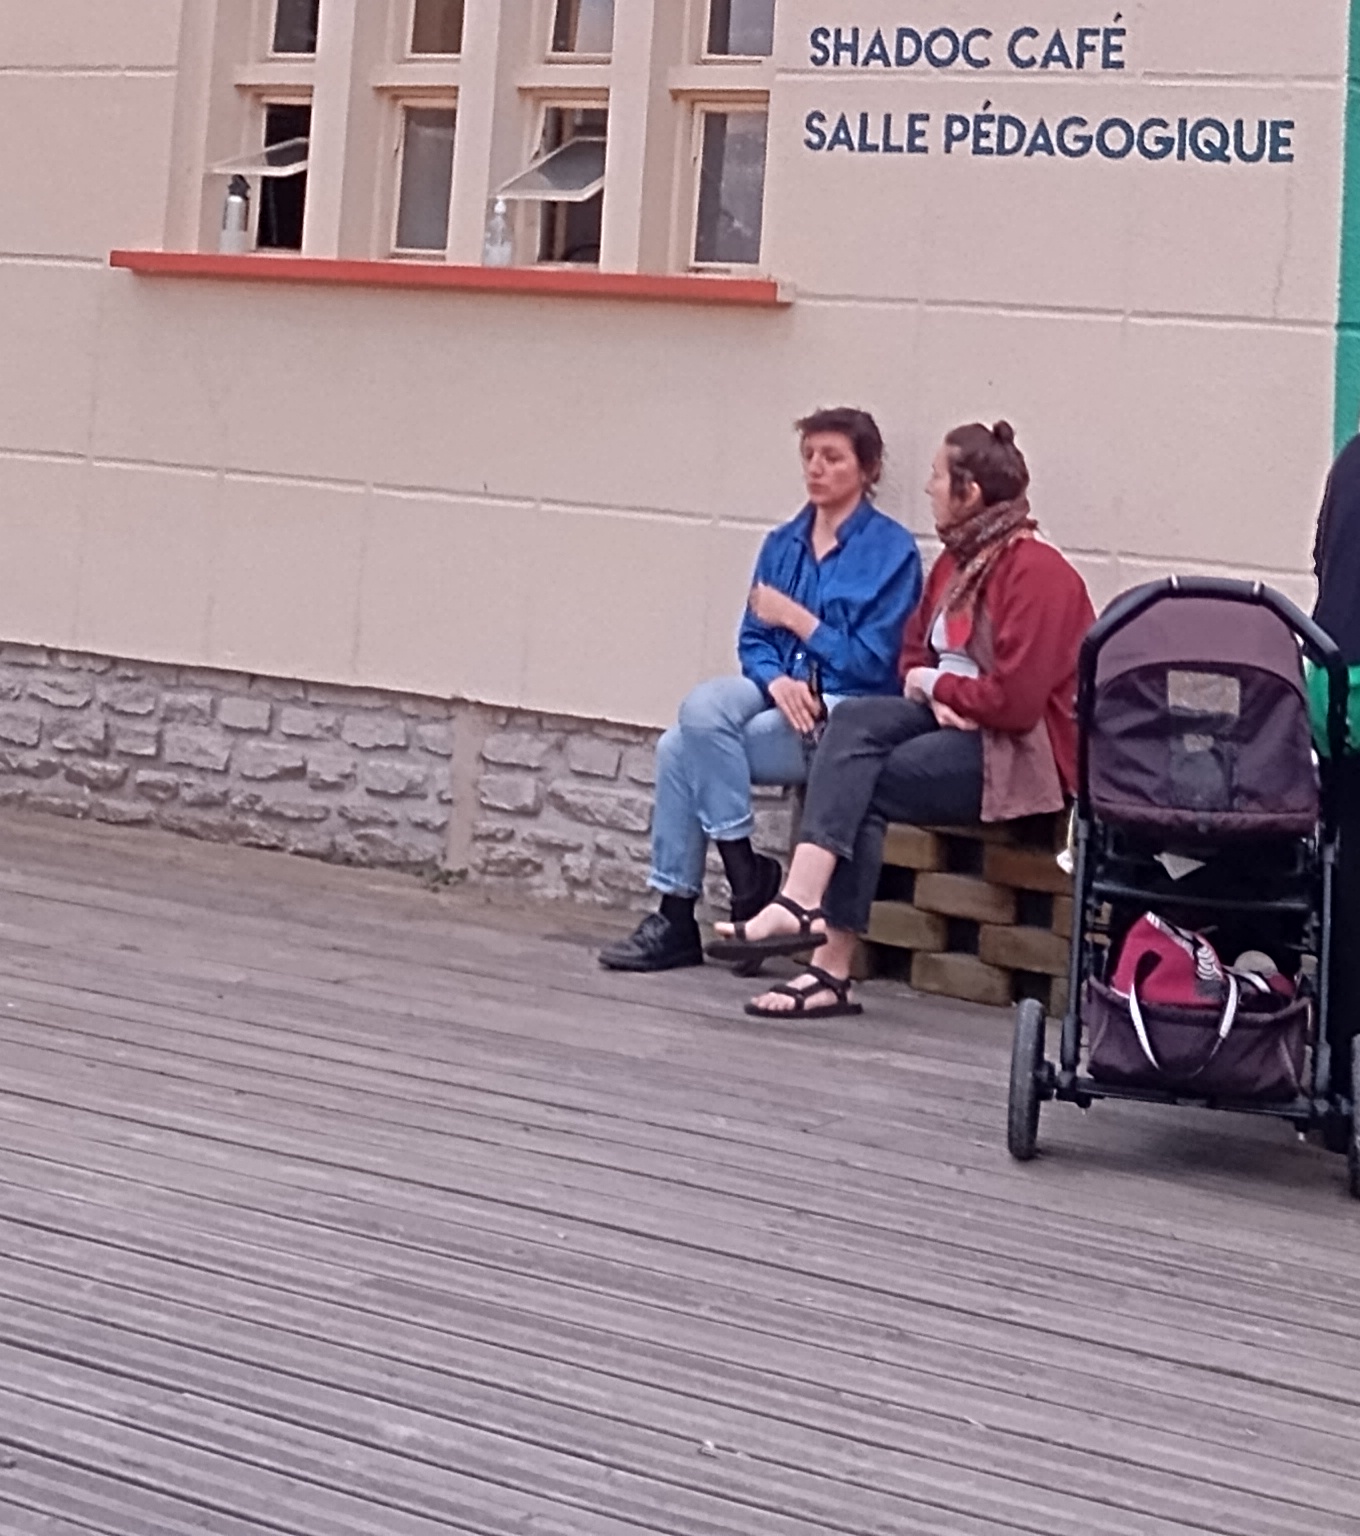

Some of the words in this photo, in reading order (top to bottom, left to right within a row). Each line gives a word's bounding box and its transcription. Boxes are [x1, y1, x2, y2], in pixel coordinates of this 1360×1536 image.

[809, 26, 993, 69] SHADOC
[1007, 11, 1128, 70] CAFÉ
[803, 110, 931, 155] SALLE
[944, 99, 1295, 164] PÉDAGOGIQUE
